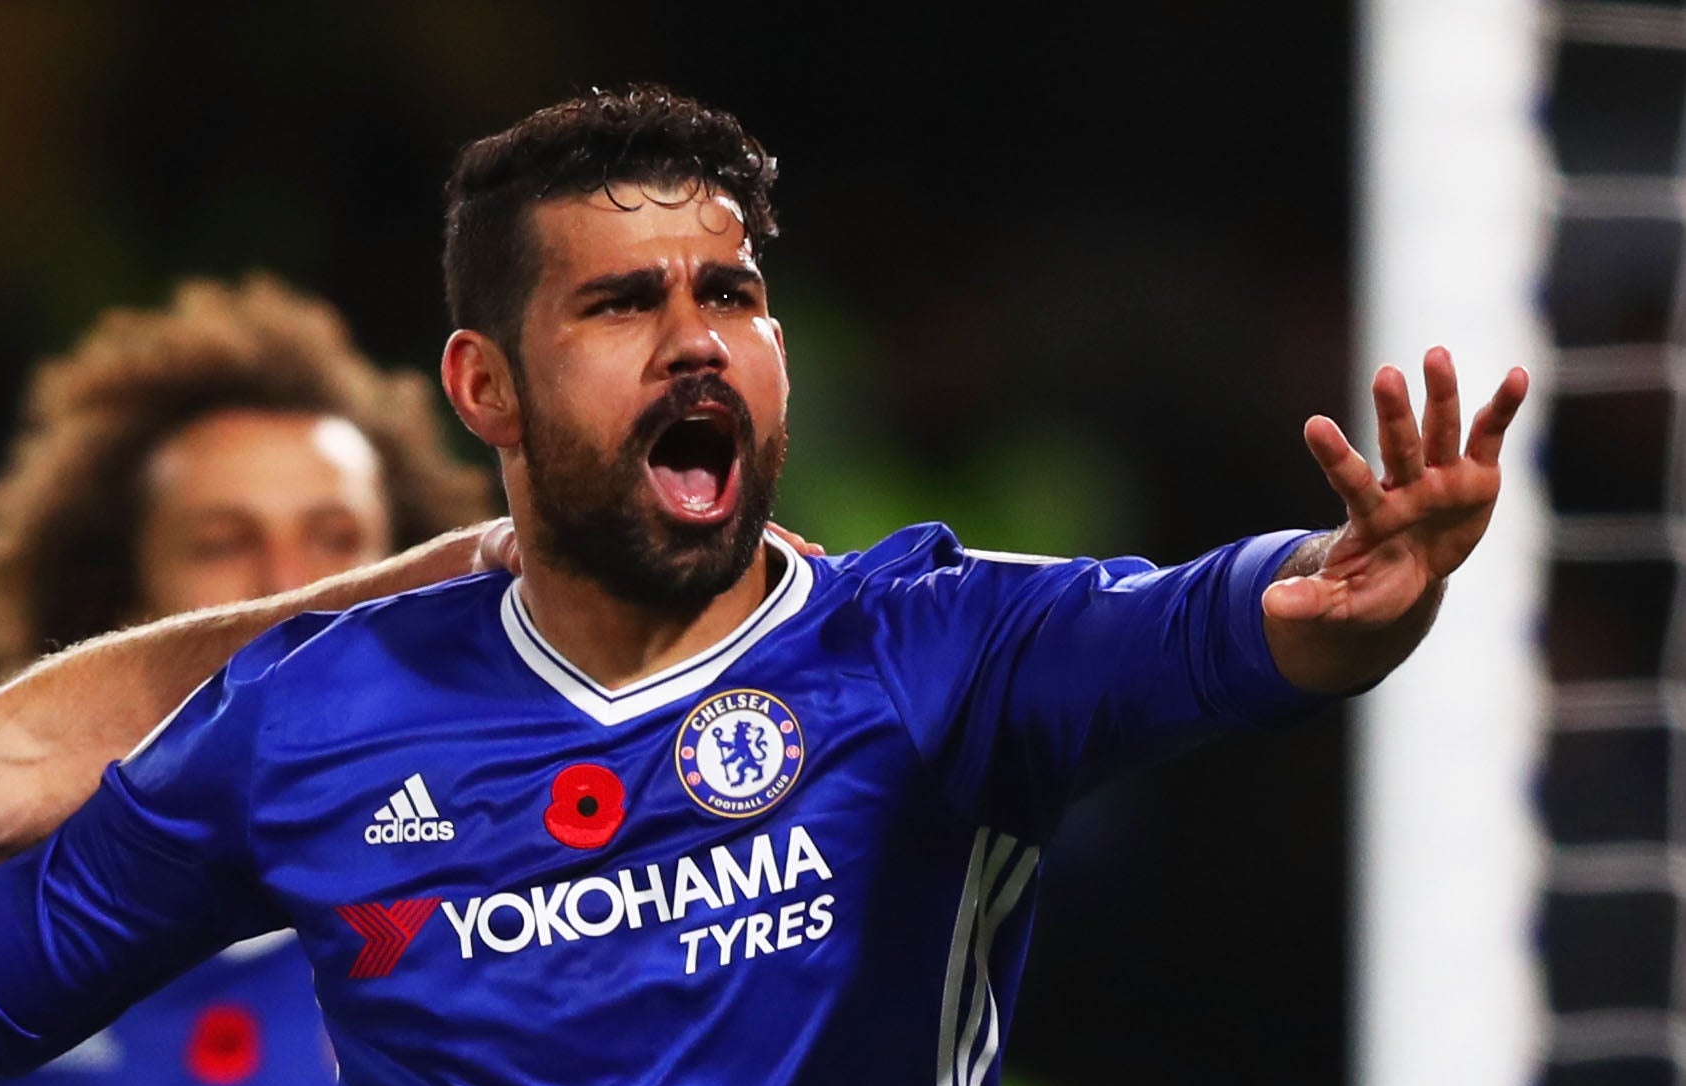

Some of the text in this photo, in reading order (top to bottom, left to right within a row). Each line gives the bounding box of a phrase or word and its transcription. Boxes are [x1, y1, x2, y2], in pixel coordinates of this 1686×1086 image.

[691, 694, 770, 731] CHELSEA
[707, 774, 790, 811] FOOTBALL CLUB
[364, 817, 455, 844] adidas
[441, 826, 832, 958] YOKOHAMA
[680, 895, 834, 974] TYRES
